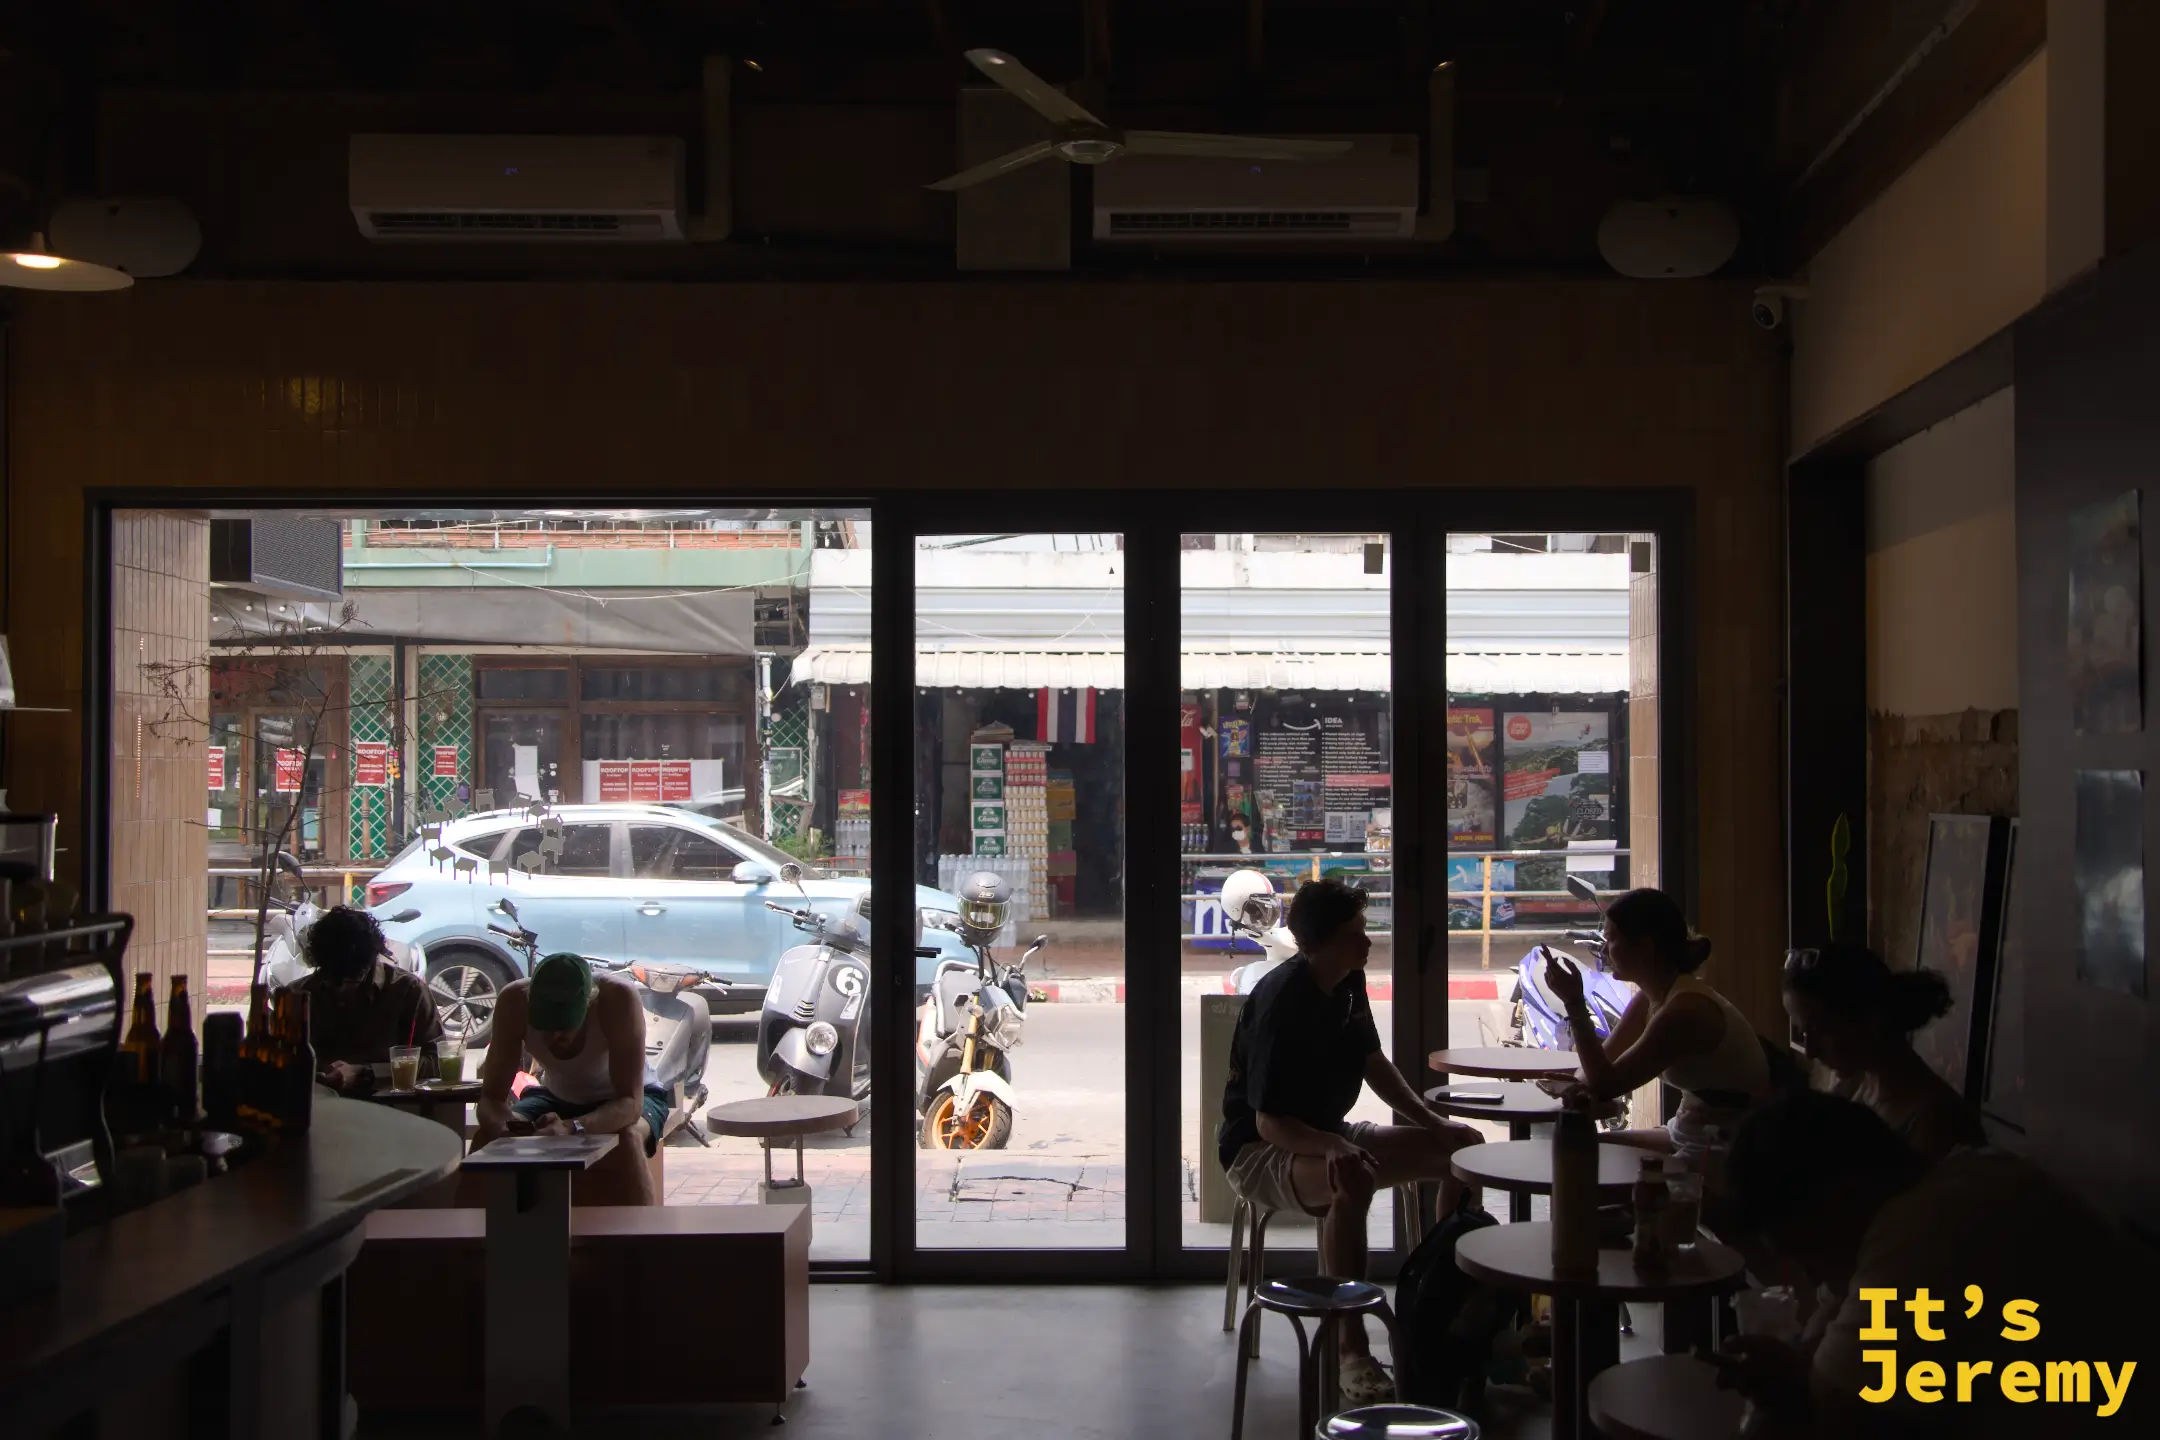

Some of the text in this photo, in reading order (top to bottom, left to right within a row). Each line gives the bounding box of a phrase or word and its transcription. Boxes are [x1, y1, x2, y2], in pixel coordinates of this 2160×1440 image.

[357, 748, 386, 756] ROOFTOP
[977, 815, 999, 823] Chang
[979, 844, 1000, 853] Chang
[836, 966, 864, 996] 6
